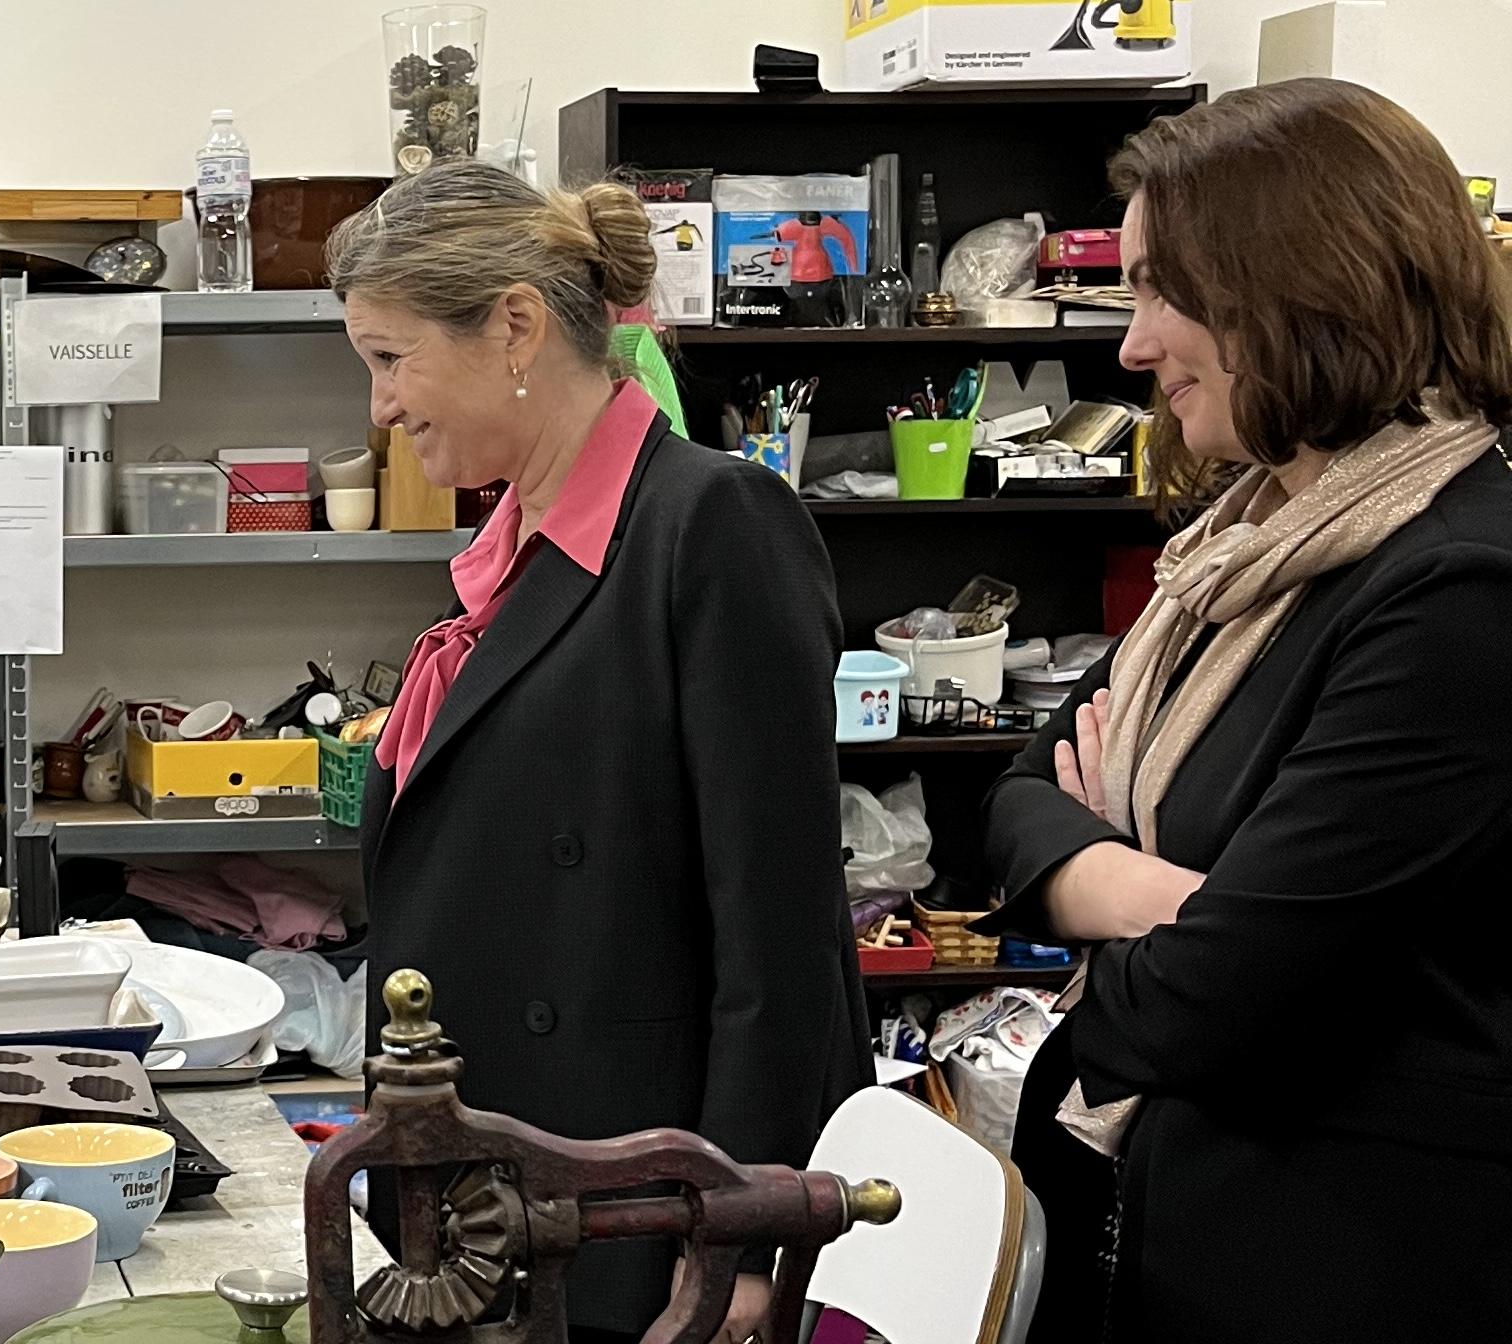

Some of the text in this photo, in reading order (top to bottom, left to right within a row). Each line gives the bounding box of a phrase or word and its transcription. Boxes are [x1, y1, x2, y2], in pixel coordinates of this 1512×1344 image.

[806, 185, 855, 198] EANER
[726, 304, 781, 316] Intertronic
[49, 341, 134, 362] VAISSELLE
[122, 1180, 160, 1197] filter
[126, 1196, 155, 1210] COFFEE
